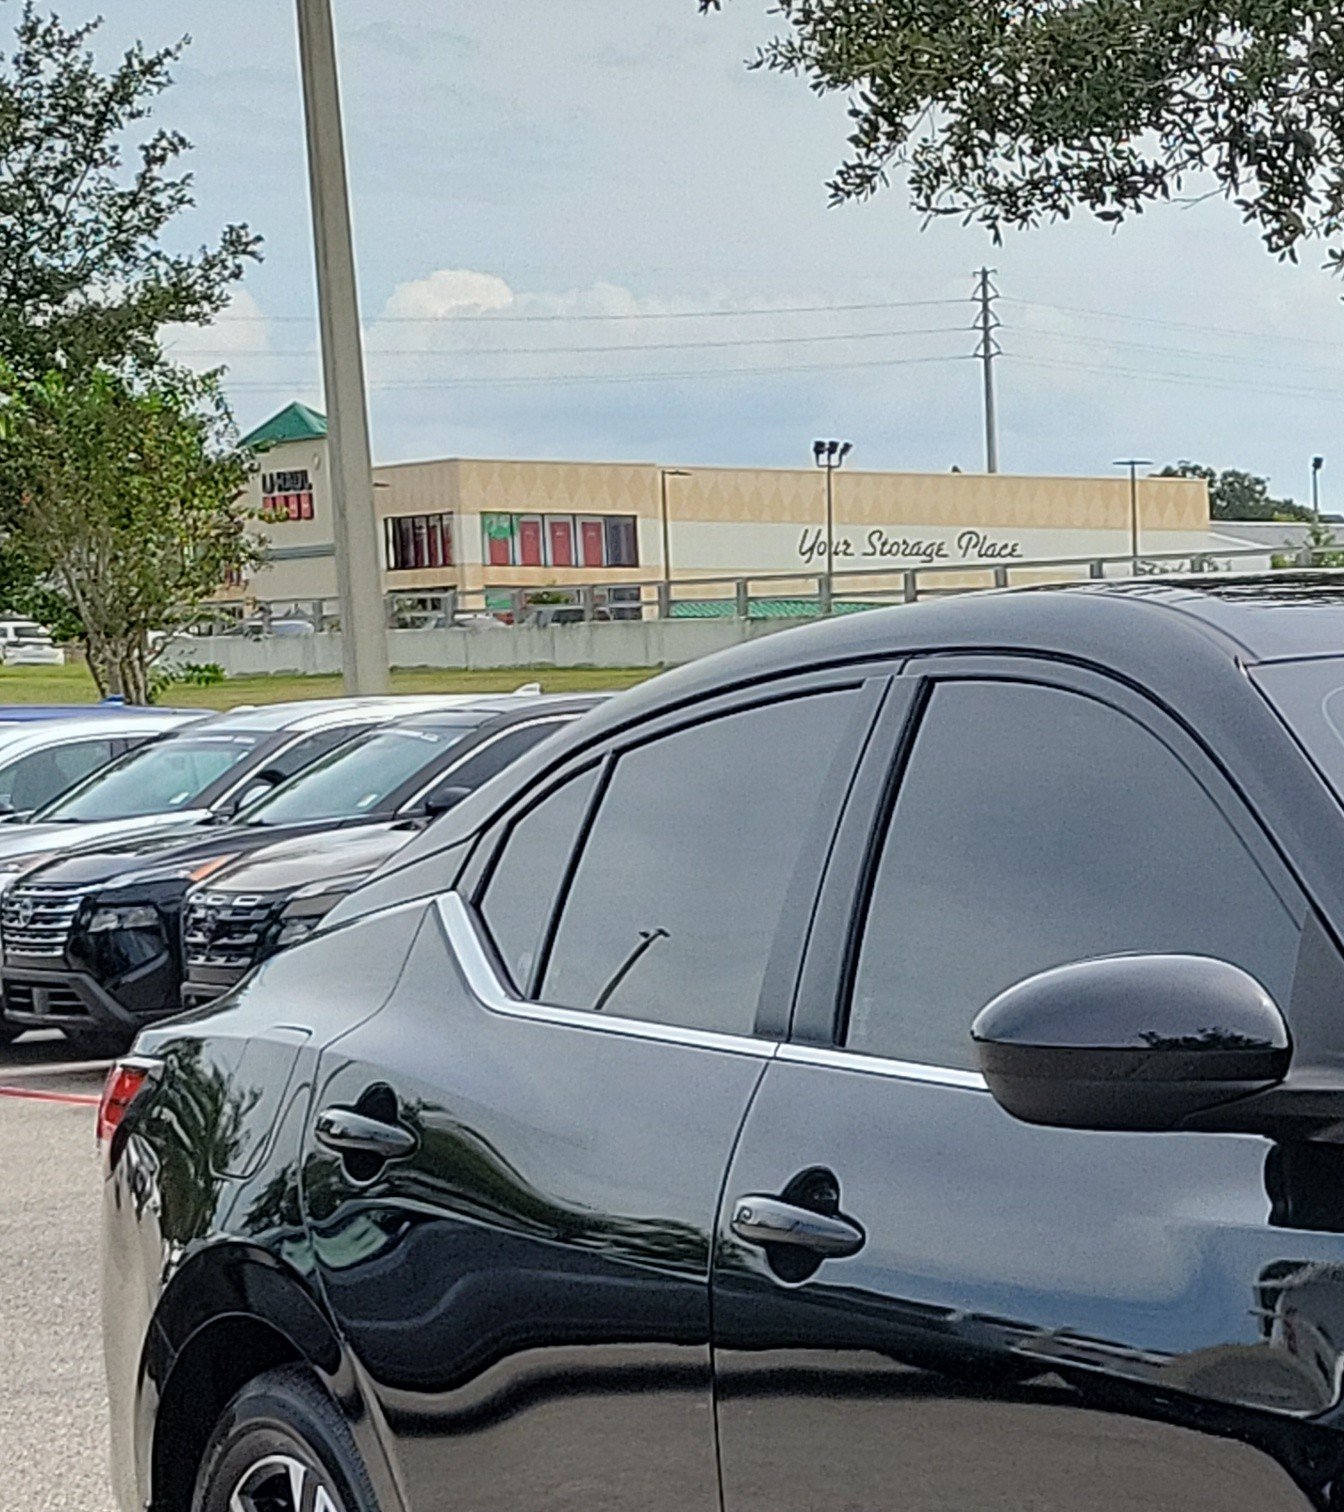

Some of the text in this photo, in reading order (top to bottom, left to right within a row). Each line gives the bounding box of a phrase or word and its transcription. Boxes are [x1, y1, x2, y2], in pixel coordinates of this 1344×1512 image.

[799, 528, 1023, 563] Your Storage Place
